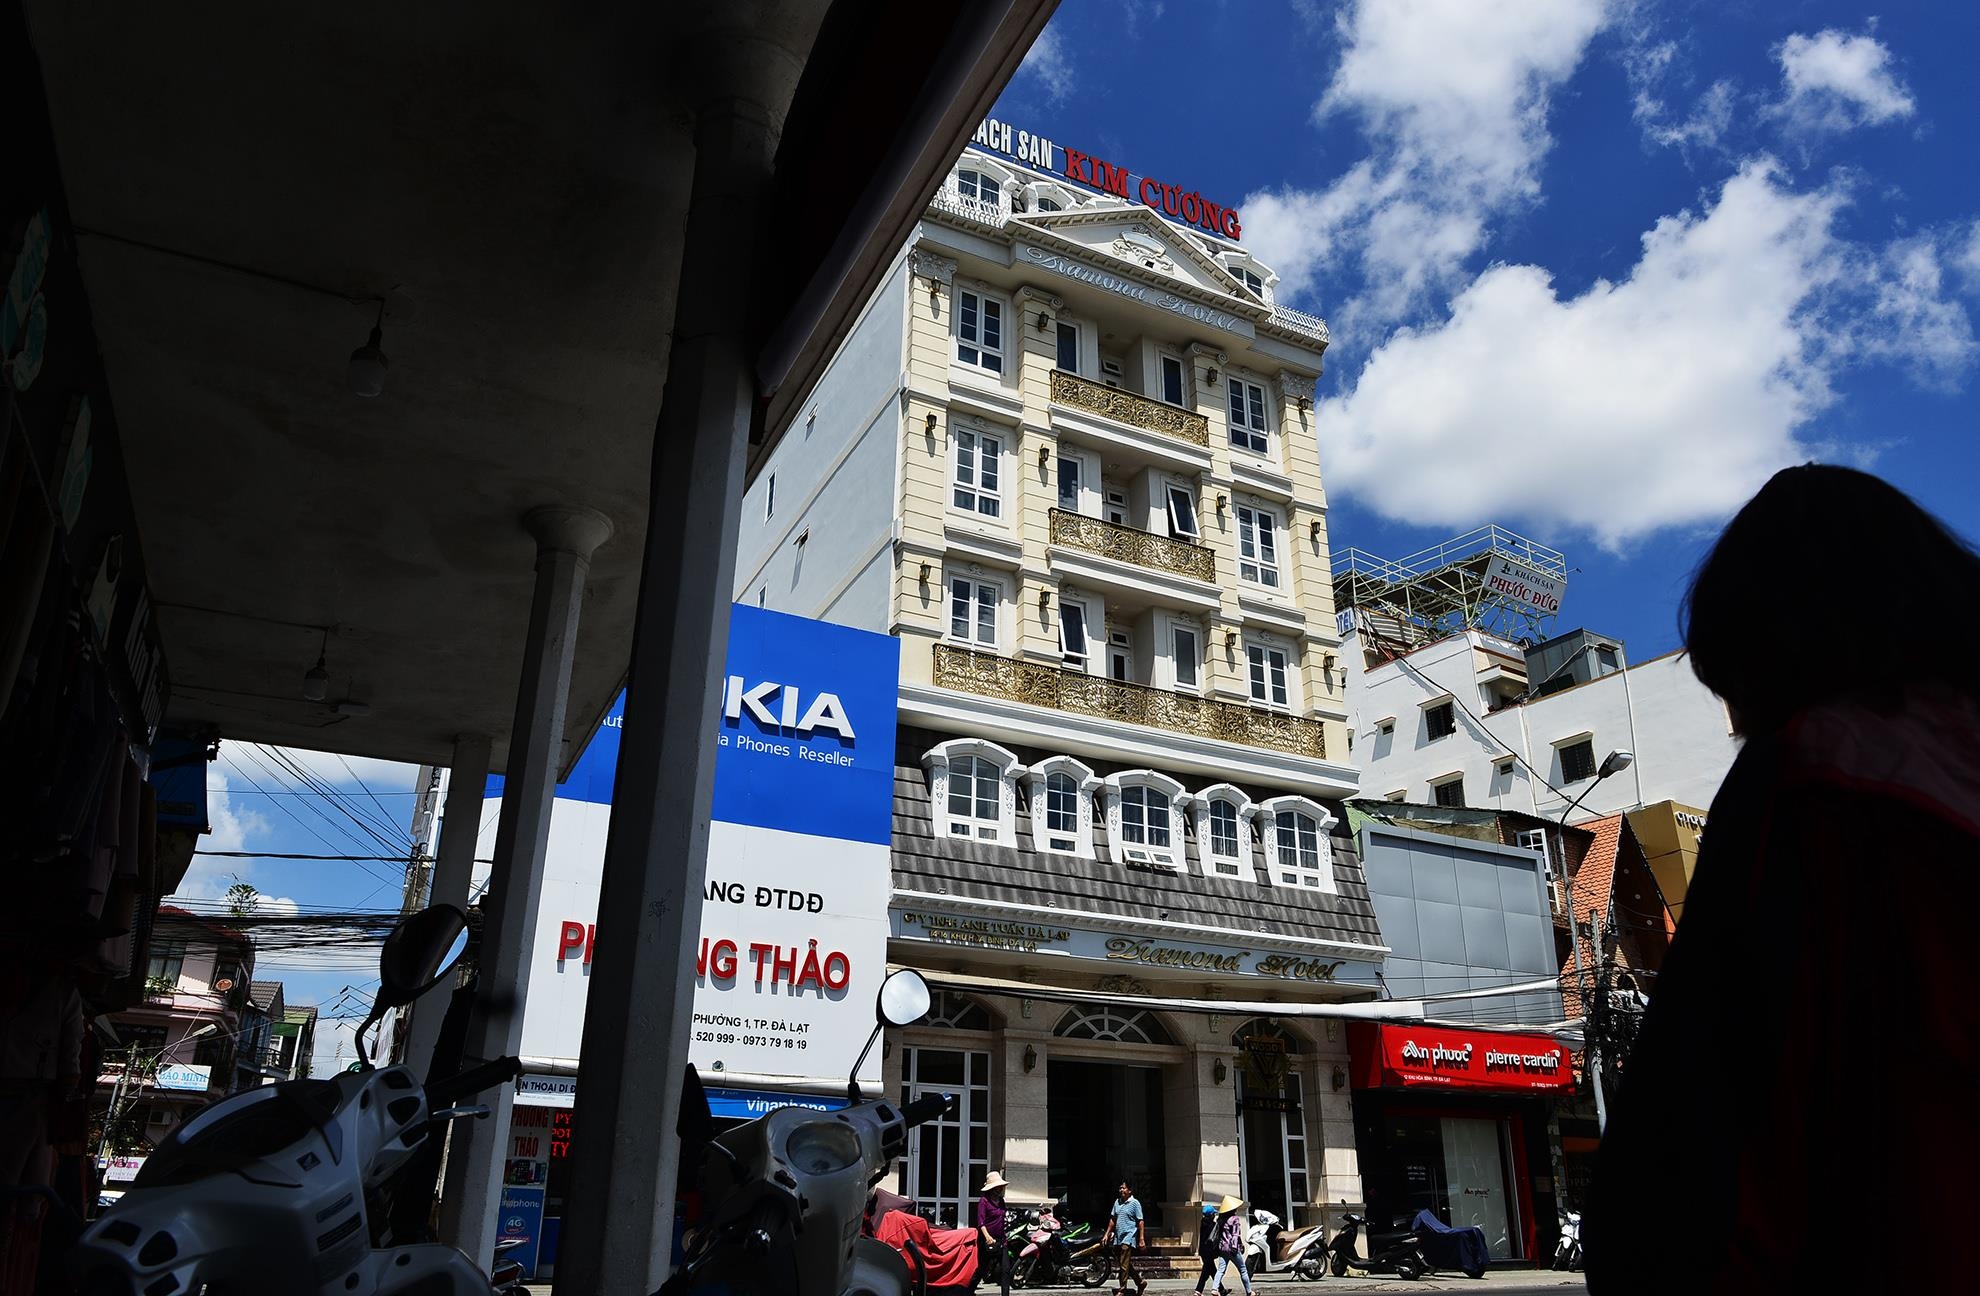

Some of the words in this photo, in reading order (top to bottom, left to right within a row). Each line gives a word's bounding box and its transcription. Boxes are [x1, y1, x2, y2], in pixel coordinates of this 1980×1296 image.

[1018, 130, 1052, 169] SẠN
[1064, 147, 1130, 200] KIM
[1139, 177, 1241, 241] CƯƠNG
[1026, 246, 1155, 301] Diamond
[1156, 294, 1245, 331] Hotel
[1488, 575, 1531, 601] PHƯỚC
[721, 675, 856, 738] KIA
[737, 735, 790, 757] Phones
[800, 746, 854, 767] Reseller
[755, 886, 824, 913] ĐTDĐ
[750, 938, 850, 990] THẢO
[1105, 938, 1250, 972] Diamond
[1256, 954, 1346, 980] Hotel
[693, 1013, 741, 1028] PHƯỜNG
[744, 1018, 751, 1029] 1,
[753, 1019, 769, 1030] TP.
[771, 1019, 786, 1031] ĐÀ
[789, 1022, 810, 1035] LẠT
[696, 1031, 714, 1042] 520
[716, 1033, 735, 1044] 999
[743, 1035, 767, 1046] 0973
[769, 1037, 781, 1048] 79
[783, 1038, 794, 1048] 18
[796, 1039, 807, 1049] 19
[1485, 1049, 1520, 1067] pierre
[1523, 1051, 1559, 1068] cardin
[531, 1081, 557, 1093] THOẠI
[507, 1219, 522, 1227] 4G
